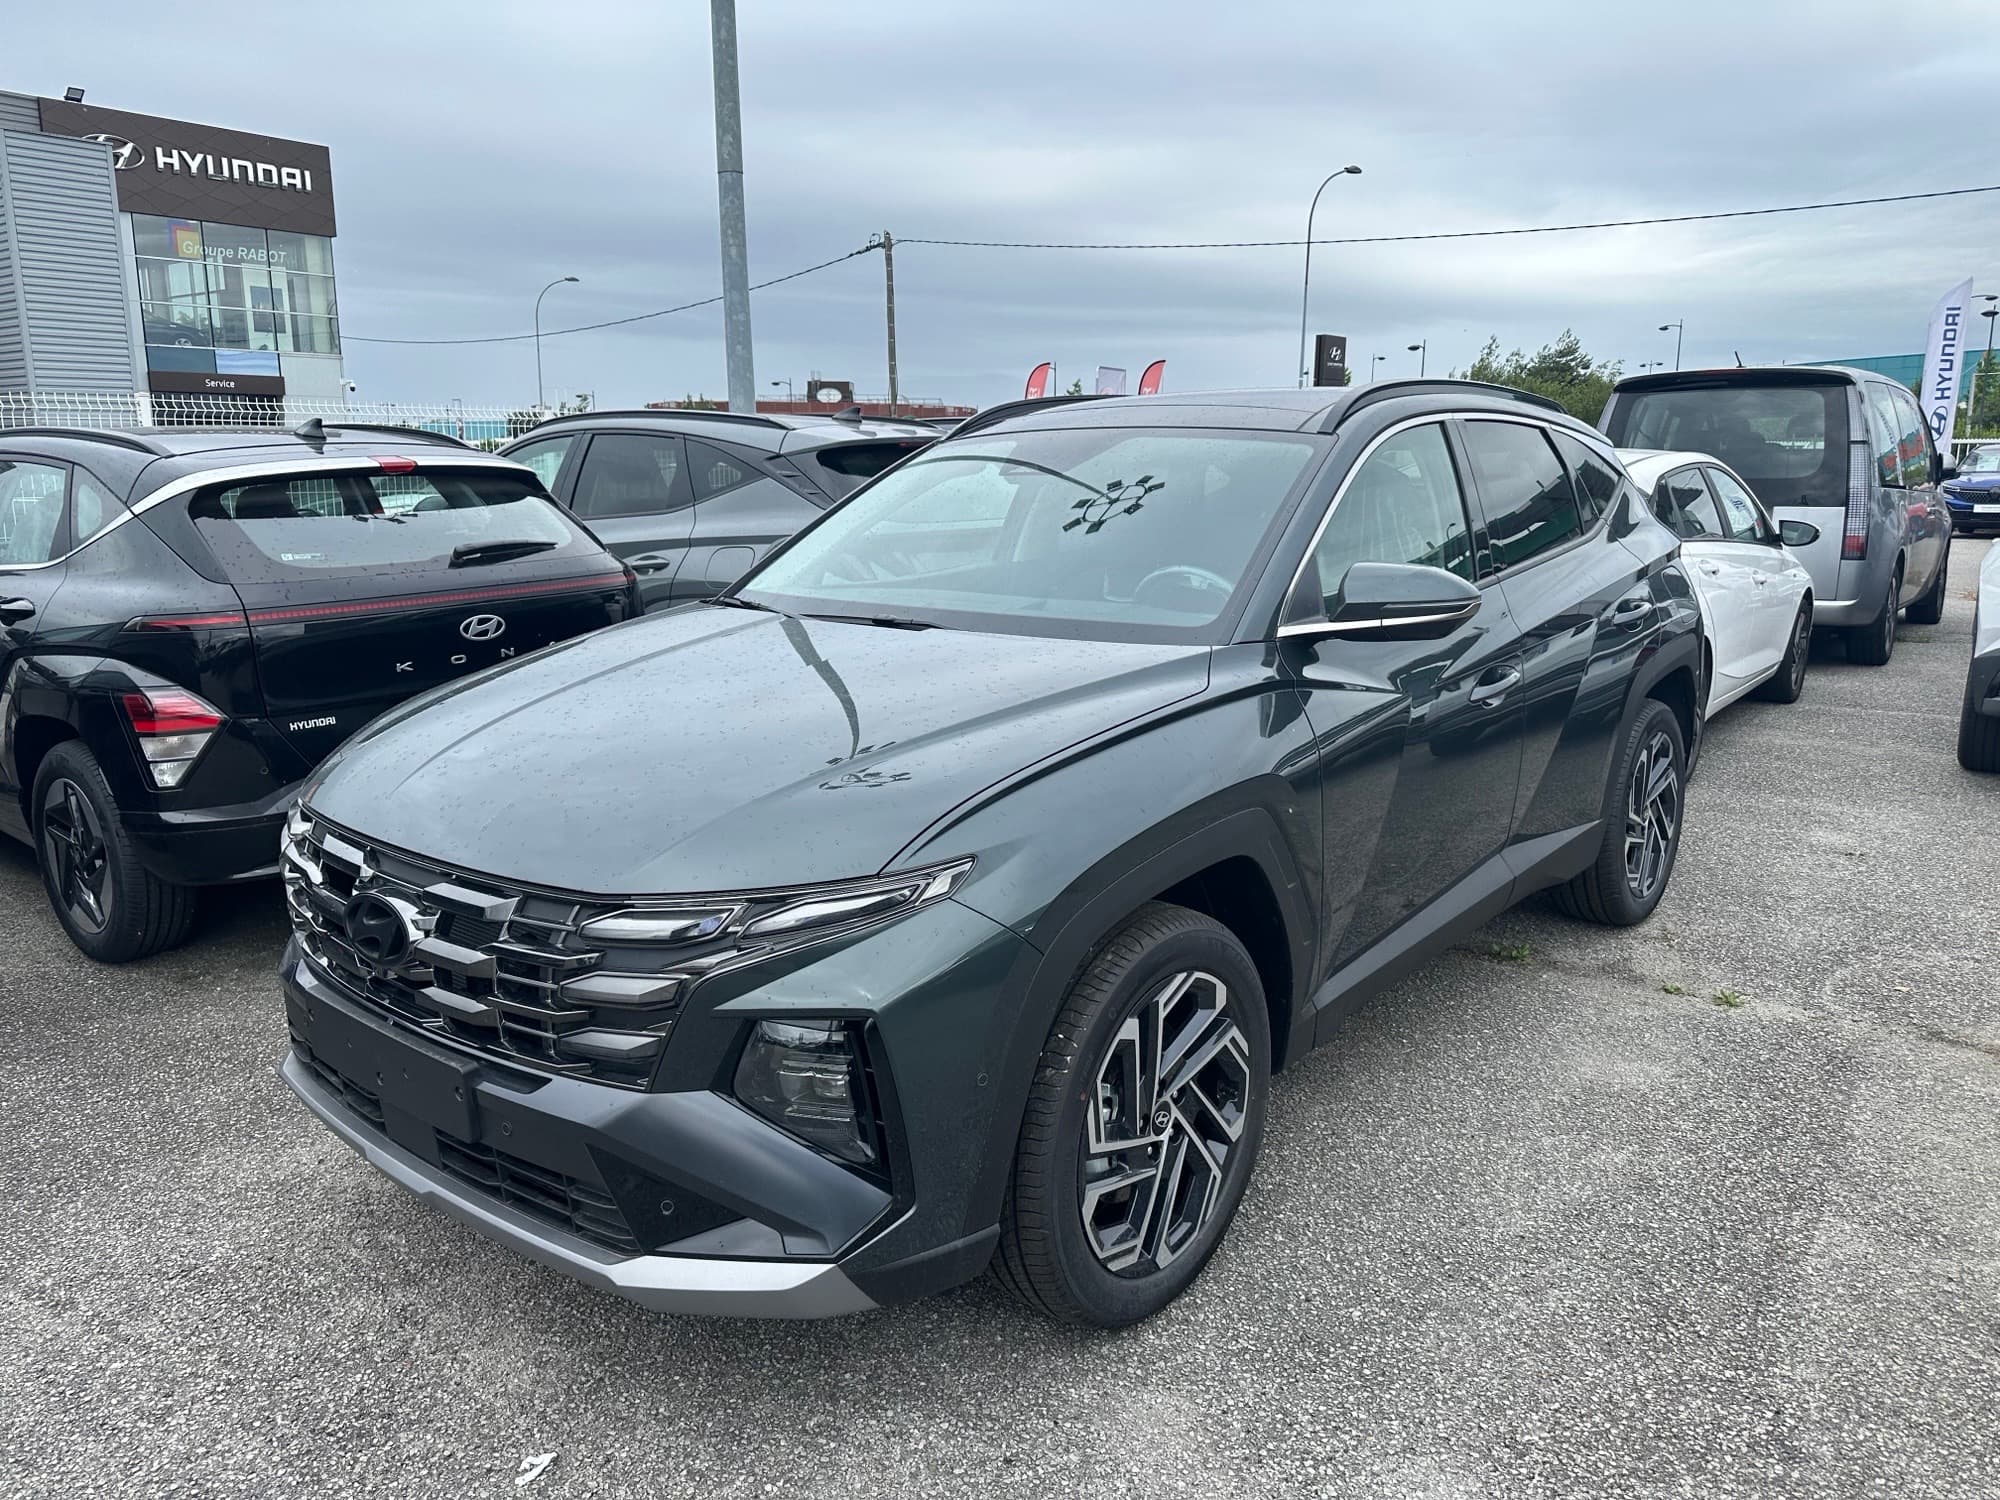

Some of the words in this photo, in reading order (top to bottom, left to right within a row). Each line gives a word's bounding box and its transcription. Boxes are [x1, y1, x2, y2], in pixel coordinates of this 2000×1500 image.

[155, 146, 312, 192] HYUNDAI
[182, 241, 234, 260] Groupe
[237, 247, 287, 263] RABOT
[1934, 306, 1961, 400] HYUNDAI
[205, 379, 235, 388] Service
[289, 716, 336, 731] HYUNDAI
